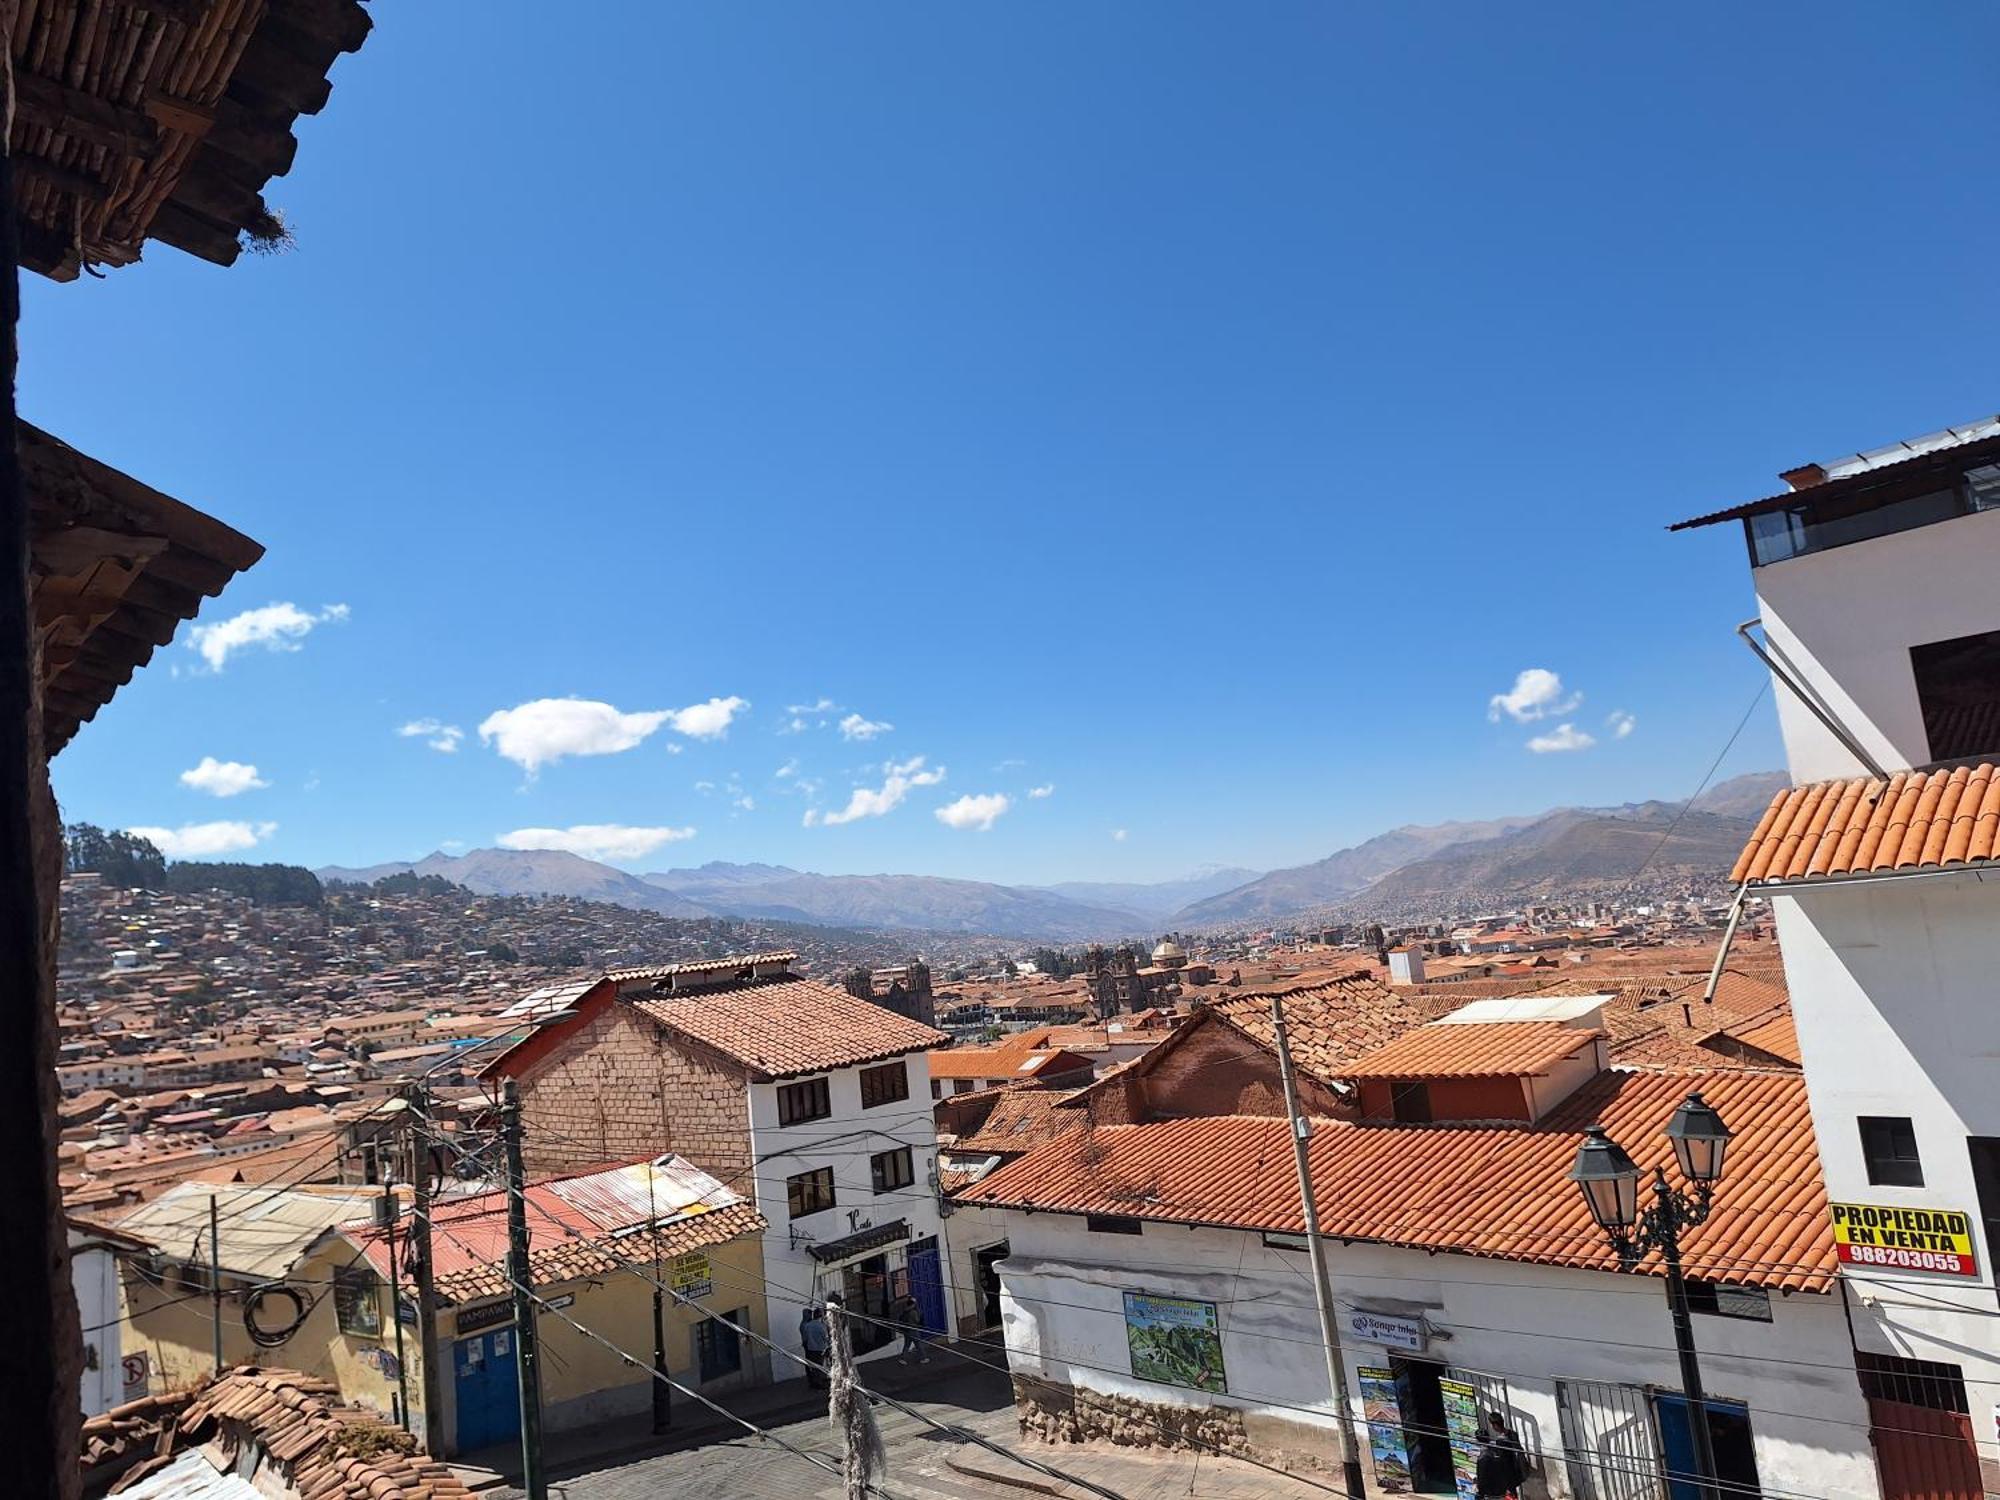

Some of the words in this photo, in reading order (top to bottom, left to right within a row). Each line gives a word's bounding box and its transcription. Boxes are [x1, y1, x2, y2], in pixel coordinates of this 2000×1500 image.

[1832, 1206, 1965, 1235] PROPIEDAD
[1847, 1227, 1876, 1244] EN
[1880, 1229, 1956, 1252] VENTA
[1850, 1245, 1961, 1272] 988203055
